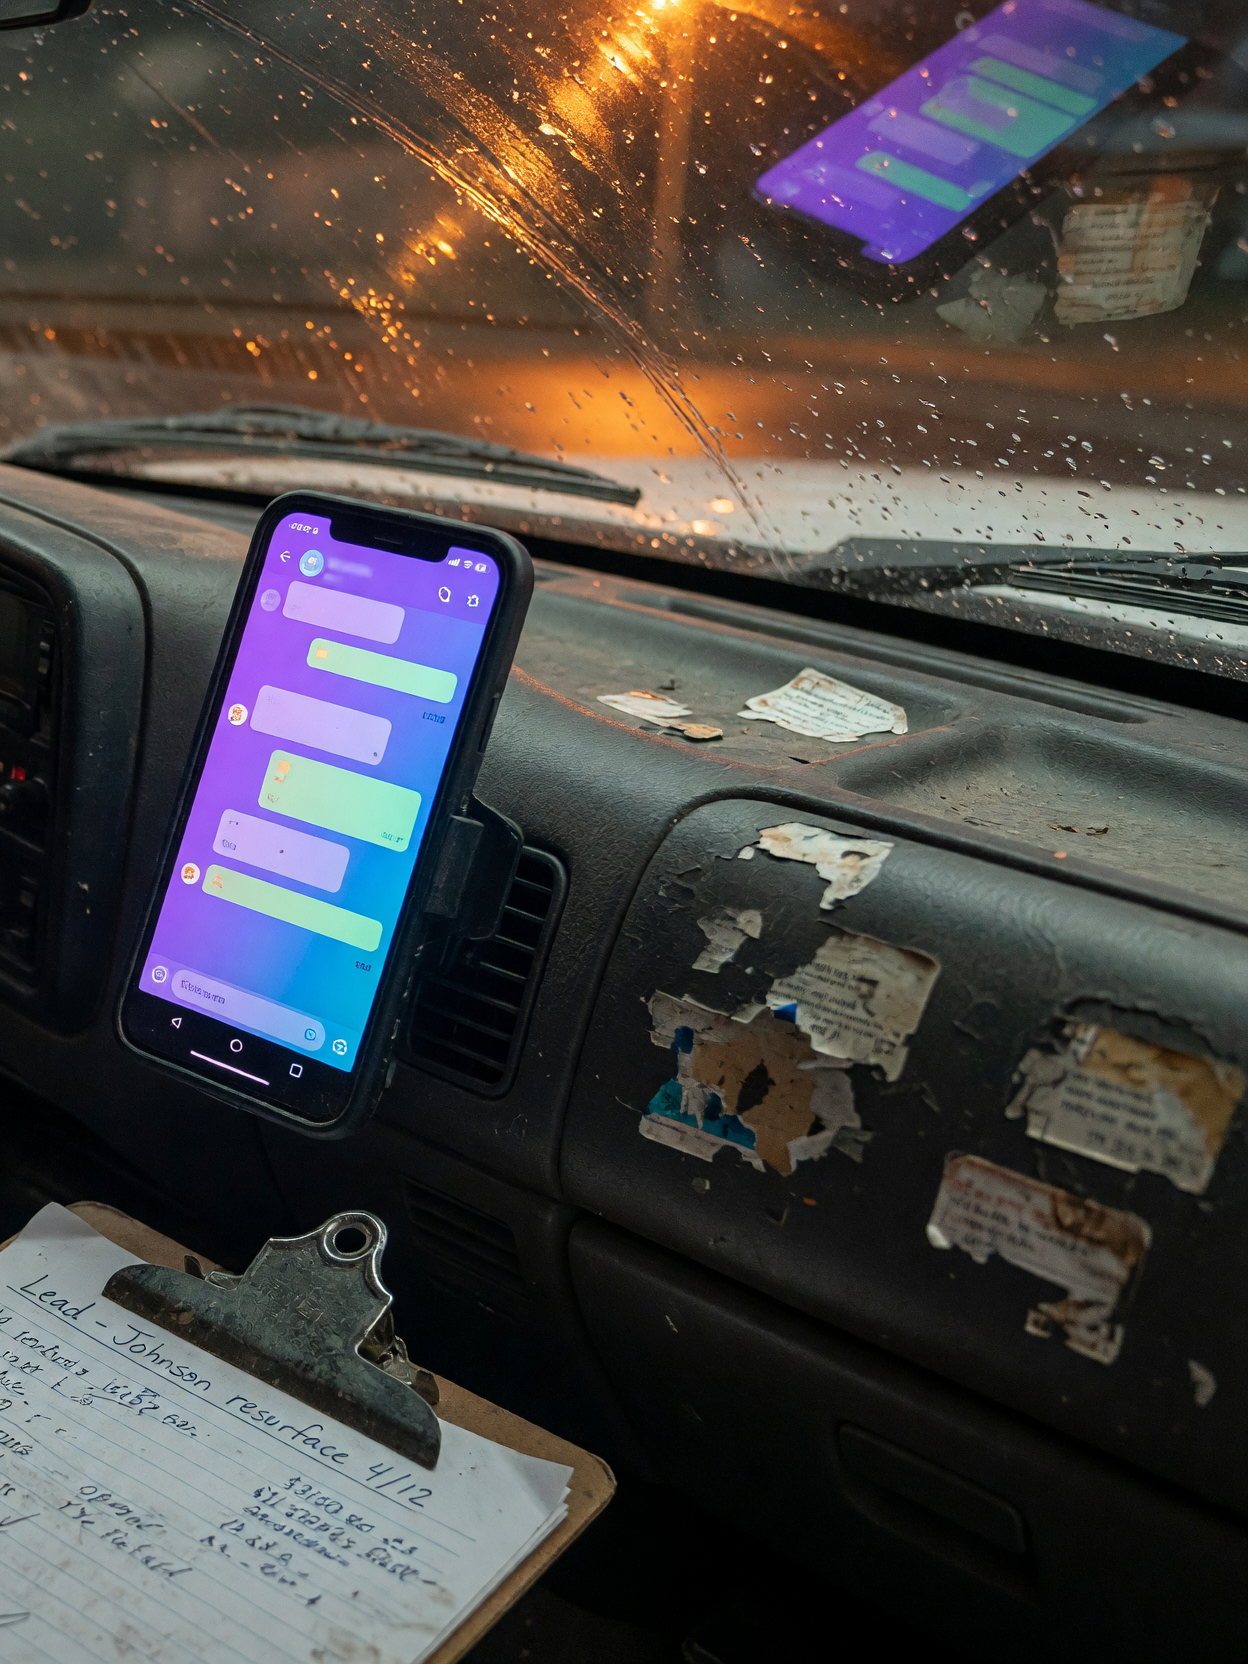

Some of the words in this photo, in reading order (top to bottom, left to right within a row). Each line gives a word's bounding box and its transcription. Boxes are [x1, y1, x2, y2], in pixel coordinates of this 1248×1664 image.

[19, 1274, 96, 1321] Lead
[112, 1324, 211, 1391] Johnson
[226, 1395, 350, 1466] resurface
[366, 1462, 433, 1508] 4/12
